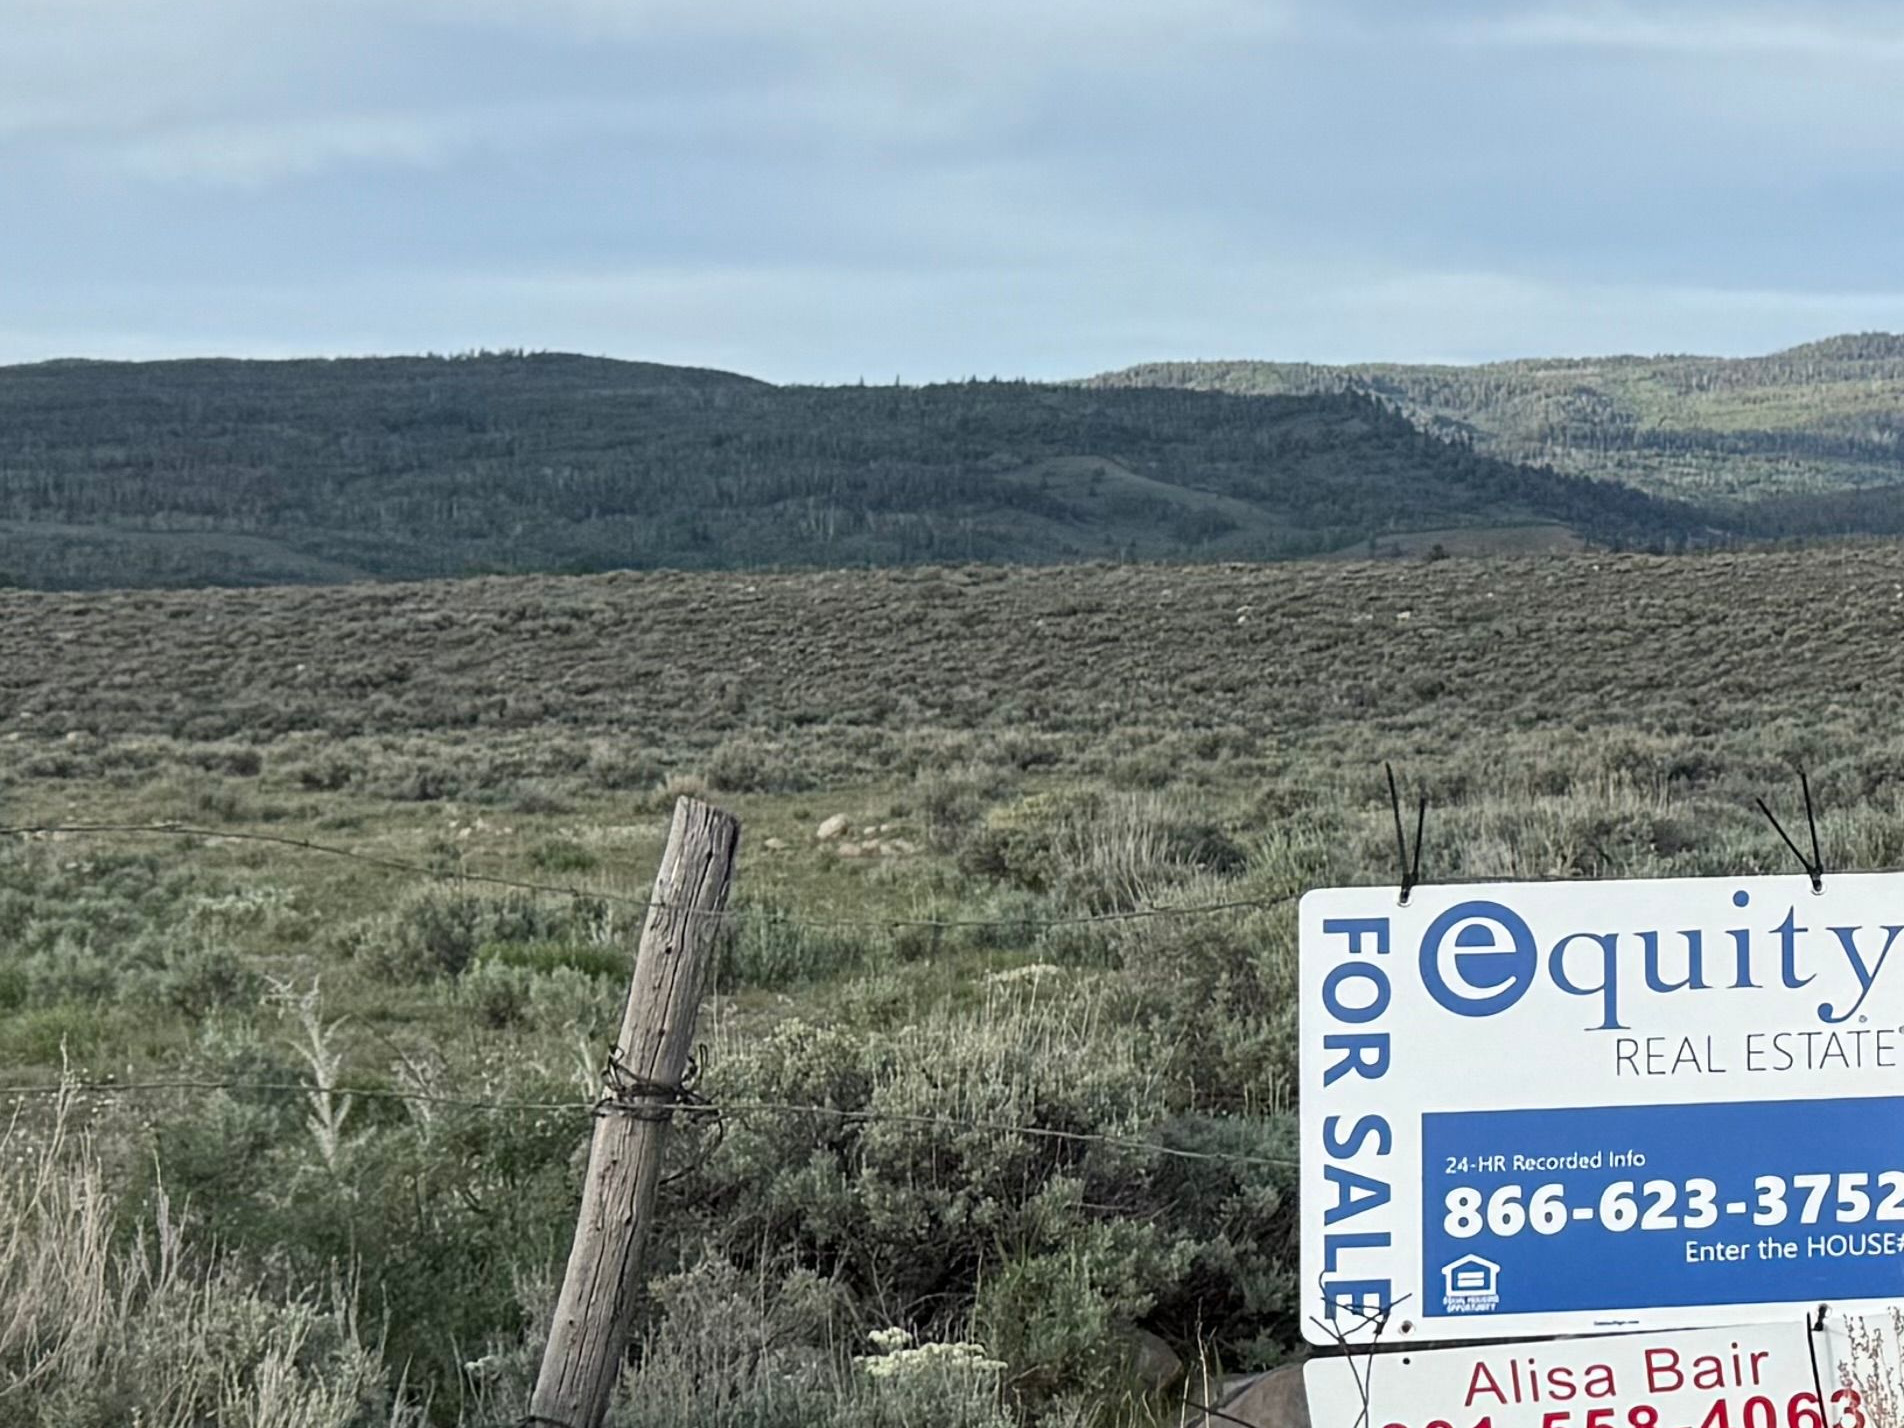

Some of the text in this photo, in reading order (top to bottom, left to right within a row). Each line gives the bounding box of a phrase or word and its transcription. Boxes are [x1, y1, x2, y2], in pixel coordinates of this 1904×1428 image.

[1616, 1036, 1727, 1076] REAL
[1322, 917, 1393, 1327] FOR SALE
[1444, 1149, 1647, 1174] 24-HR Recorded Info
[1685, 1240, 1752, 1264] Enter
[1757, 1237, 1798, 1261] the
[1464, 1342, 1770, 1407] Alisa Bair
